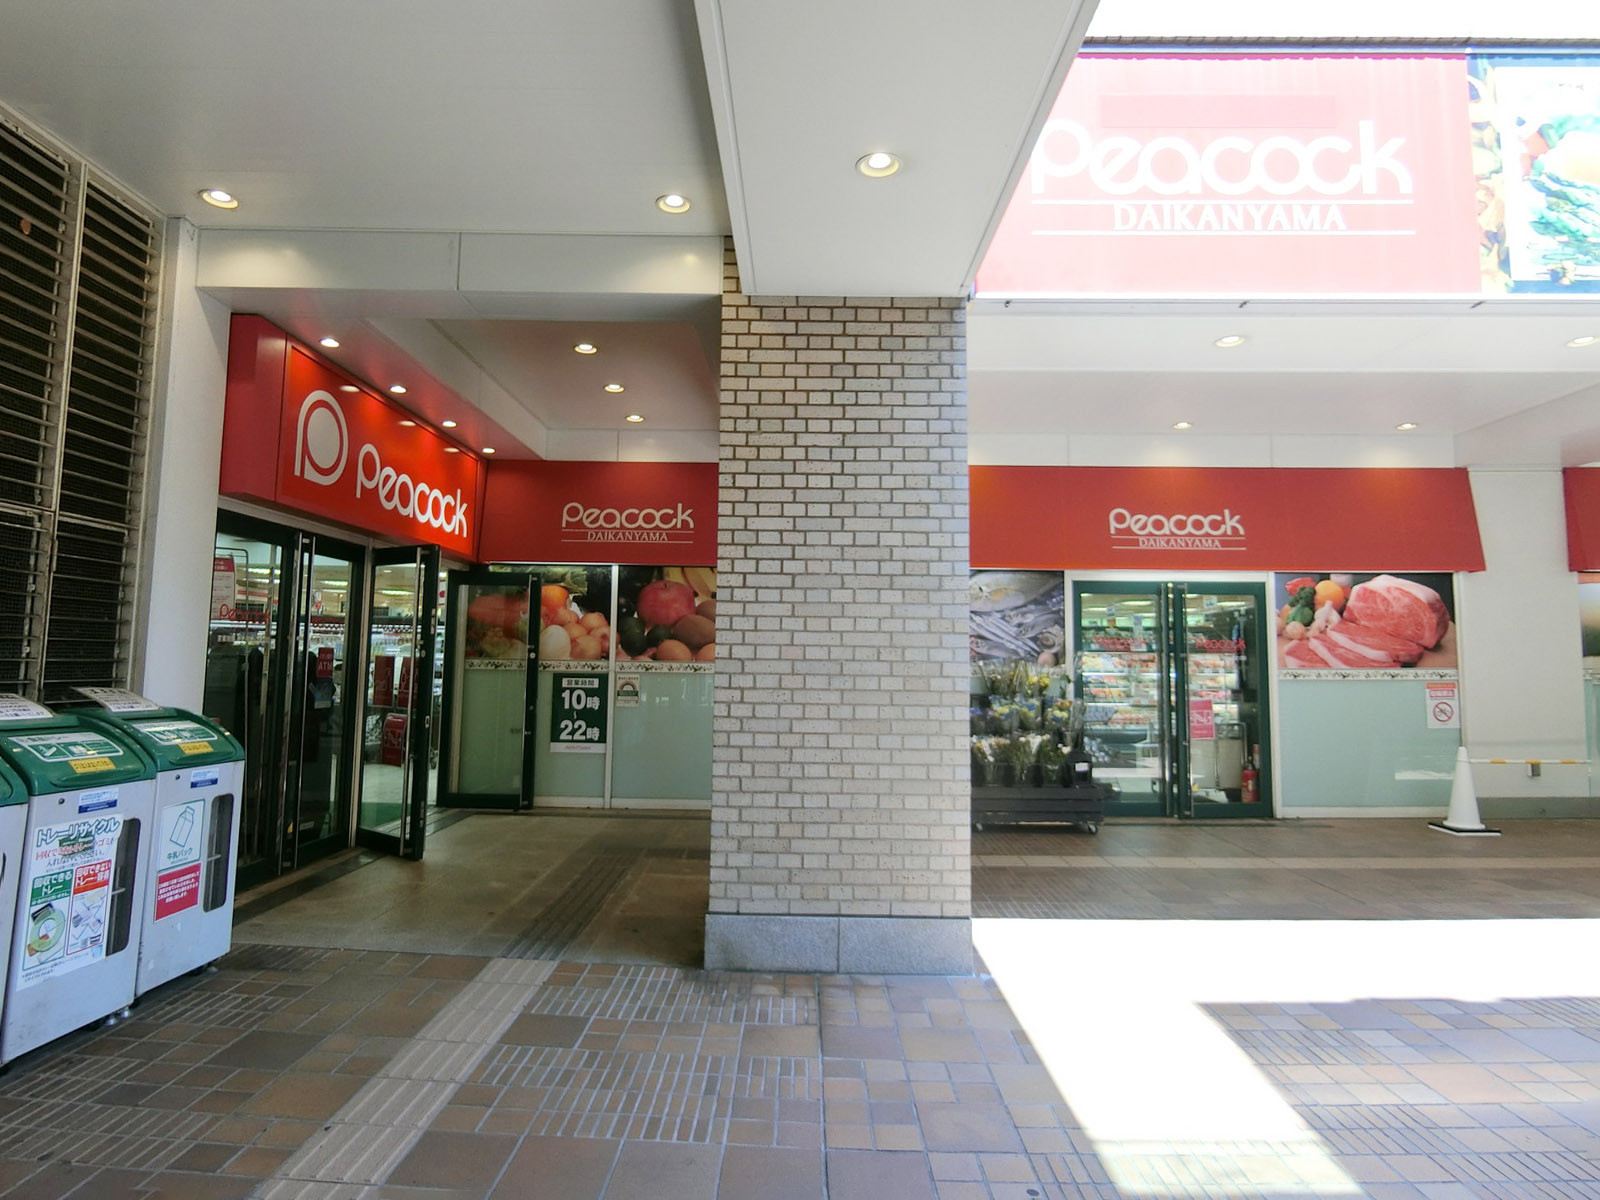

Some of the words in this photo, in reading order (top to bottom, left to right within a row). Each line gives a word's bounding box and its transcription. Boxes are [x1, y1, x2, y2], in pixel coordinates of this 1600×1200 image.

[1032, 119, 1413, 195] Peacock
[1113, 203, 1347, 231] DAIKANYAMA
[356, 443, 468, 538] Peacock
[561, 502, 695, 529] Peacock
[1109, 508, 1245, 536] Peacock
[587, 531, 668, 542] DAIKANYAMA
[1138, 537, 1222, 549] DAIKANYAMA
[561, 689, 600, 710] 10時
[559, 719, 600, 741] 22時
[36, 816, 121, 848] トレーリサイクル
[167, 847, 193, 861] 牛乳パック
[41, 885, 63, 897] トレー
